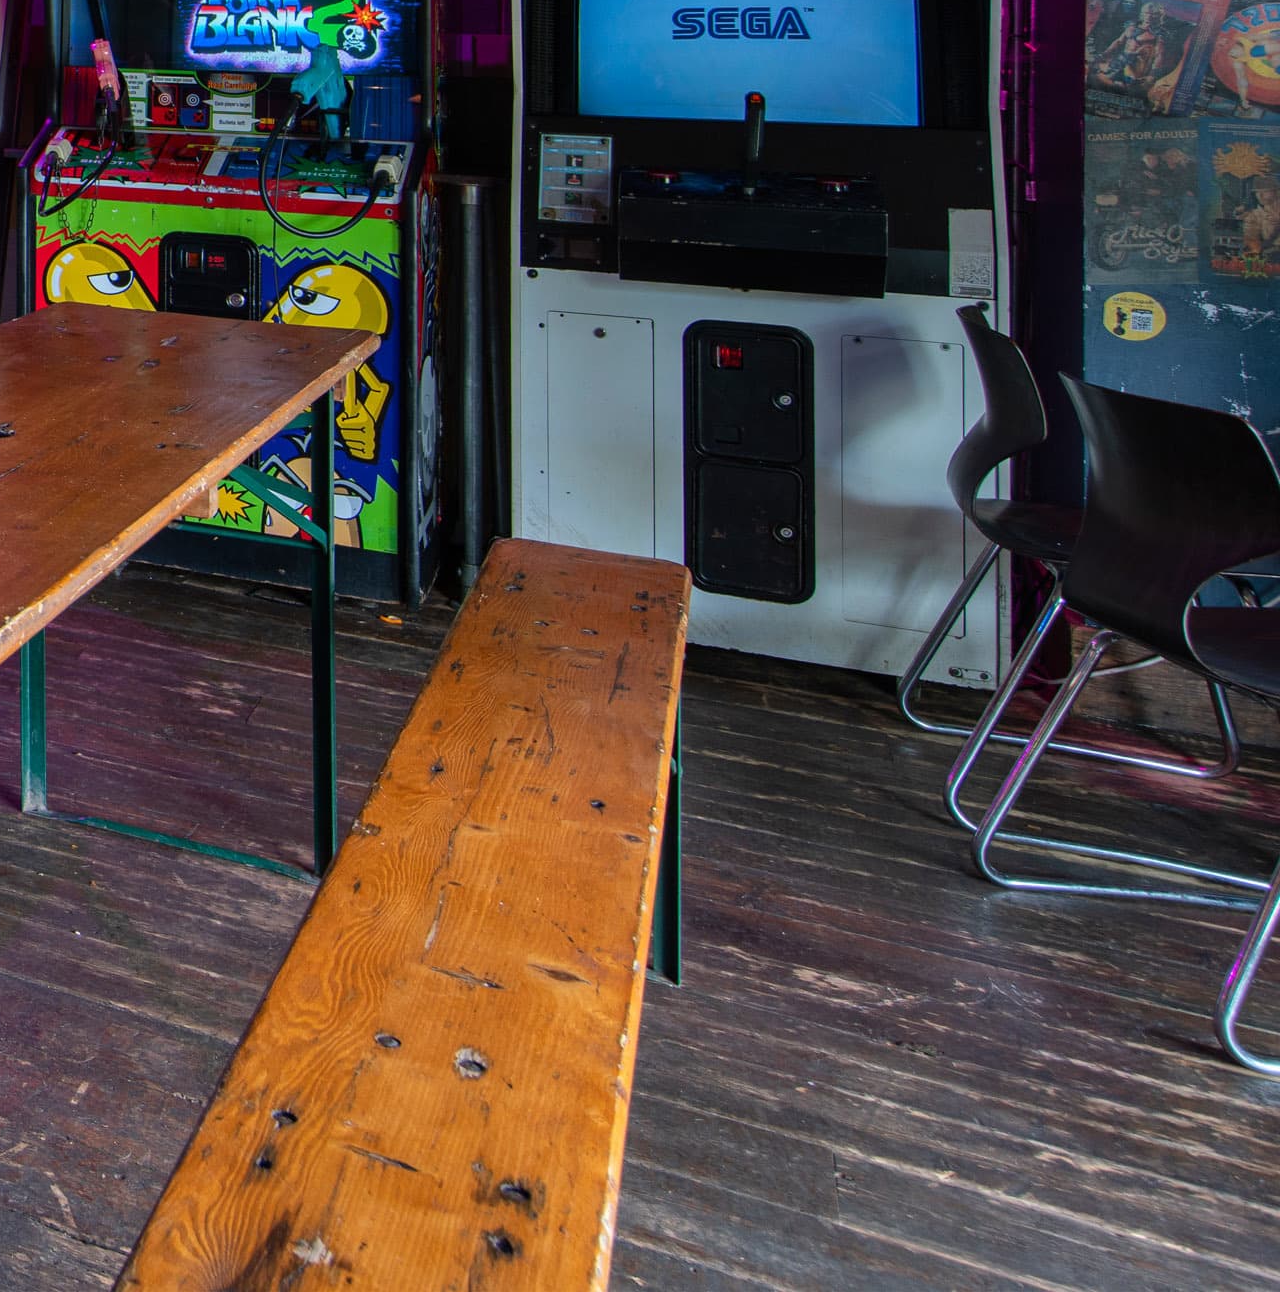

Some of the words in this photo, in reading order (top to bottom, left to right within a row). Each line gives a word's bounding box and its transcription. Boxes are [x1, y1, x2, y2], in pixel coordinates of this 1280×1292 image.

[192, 4, 321, 50] BLANK
[671, 6, 811, 40] SEGA
[1088, 132, 1128, 142] GAMES
[1130, 131, 1152, 140] FOR
[1154, 130, 1199, 140] ADULTS
